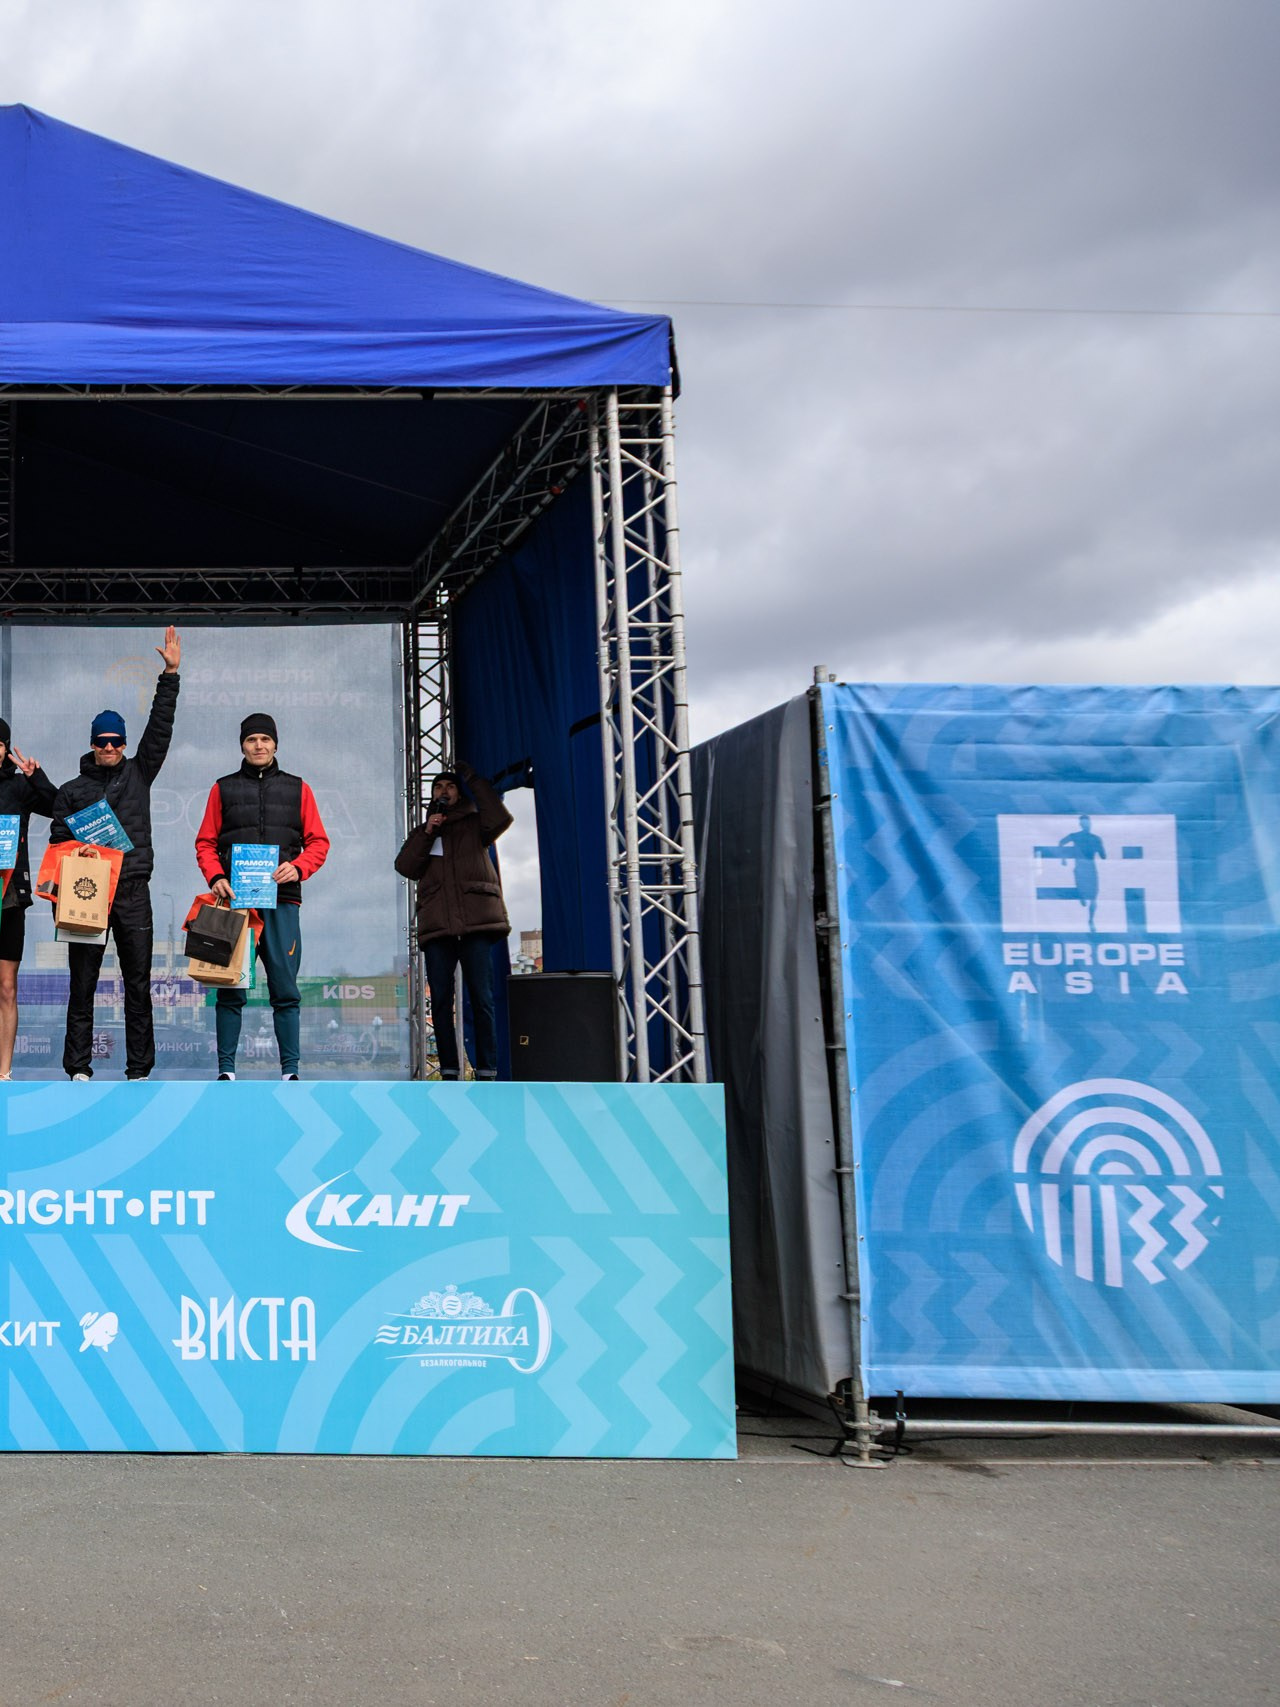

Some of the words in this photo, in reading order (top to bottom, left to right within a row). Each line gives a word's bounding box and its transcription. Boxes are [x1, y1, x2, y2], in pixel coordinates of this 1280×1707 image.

[219, 668, 314, 683] АПРЕЛЯ
[184, 691, 367, 706] ЕКАТЕРИНБУРГ
[75, 813, 112, 835] ГРАМОТА
[234, 859, 275, 867] ГРАМОТА
[1003, 942, 1185, 967] EUROPE
[323, 985, 376, 1000] KIDS
[1006, 970, 1189, 995] ASIA
[315, 1193, 471, 1227] КАНТ
[172, 1294, 317, 1362] ВИСТА
[400, 1325, 530, 1346] БАЛТИКА
[420, 1358, 487, 1368] БЕЗАЛКОГОЛЬНОЕ
